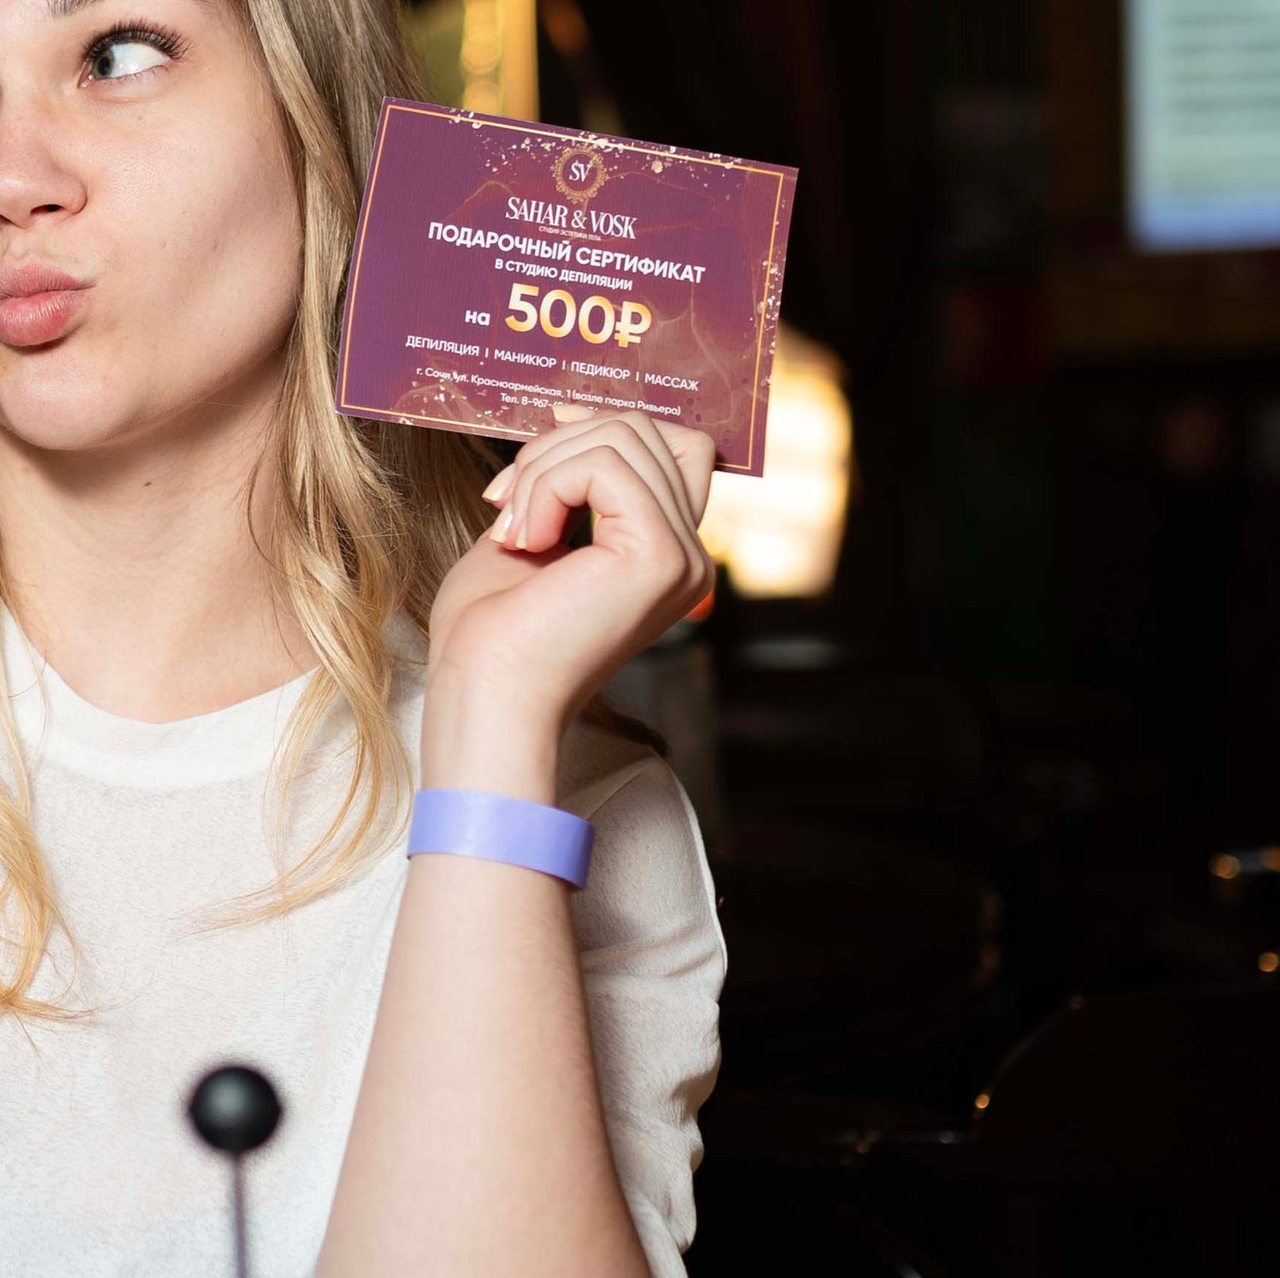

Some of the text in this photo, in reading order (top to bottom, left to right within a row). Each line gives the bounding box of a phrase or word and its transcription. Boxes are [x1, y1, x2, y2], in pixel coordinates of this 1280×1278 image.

[569, 161, 592, 182] SV
[505, 197, 637, 240] SAHAR & VOSK
[428, 222, 706, 284] ПОДАРОЧНЫЙ СЕРТИФИКАТ
[494, 258, 633, 291] В СТУДИЮ ДЕПИЛЯЦИИ
[464, 283, 652, 348] на 500₽
[405, 335, 699, 391] ДЕПИЛЯЦИЯ МАНИКЮР ПЕДИКЮР МАССАЖ
[416, 368, 423, 376] г.
[566, 389, 571, 399] 1
[572, 389, 603, 404] (возле
[605, 397, 636, 410] парка
[637, 400, 681, 416] Ривьера)
[500, 392, 520, 405] Тел.
